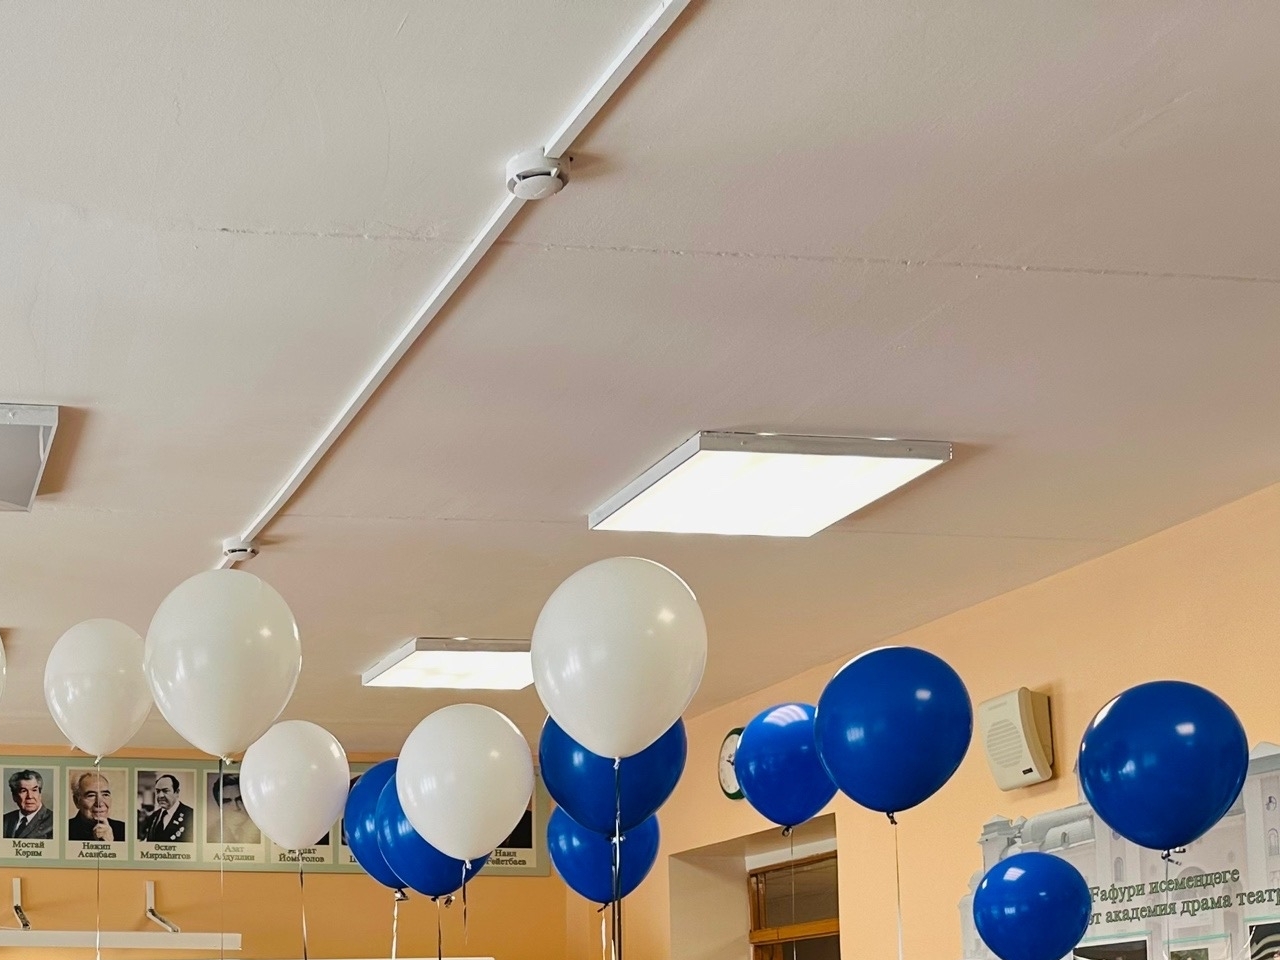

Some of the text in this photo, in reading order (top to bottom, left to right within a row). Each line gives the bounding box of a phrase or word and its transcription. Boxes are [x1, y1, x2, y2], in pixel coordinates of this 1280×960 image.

[12, 840, 45, 849] Мостай
[78, 850, 116, 858] Асанбаев
[1149, 868, 1240, 895] исемендәге
[1105, 901, 1176, 923] академия
[1180, 894, 1232, 916] драма
